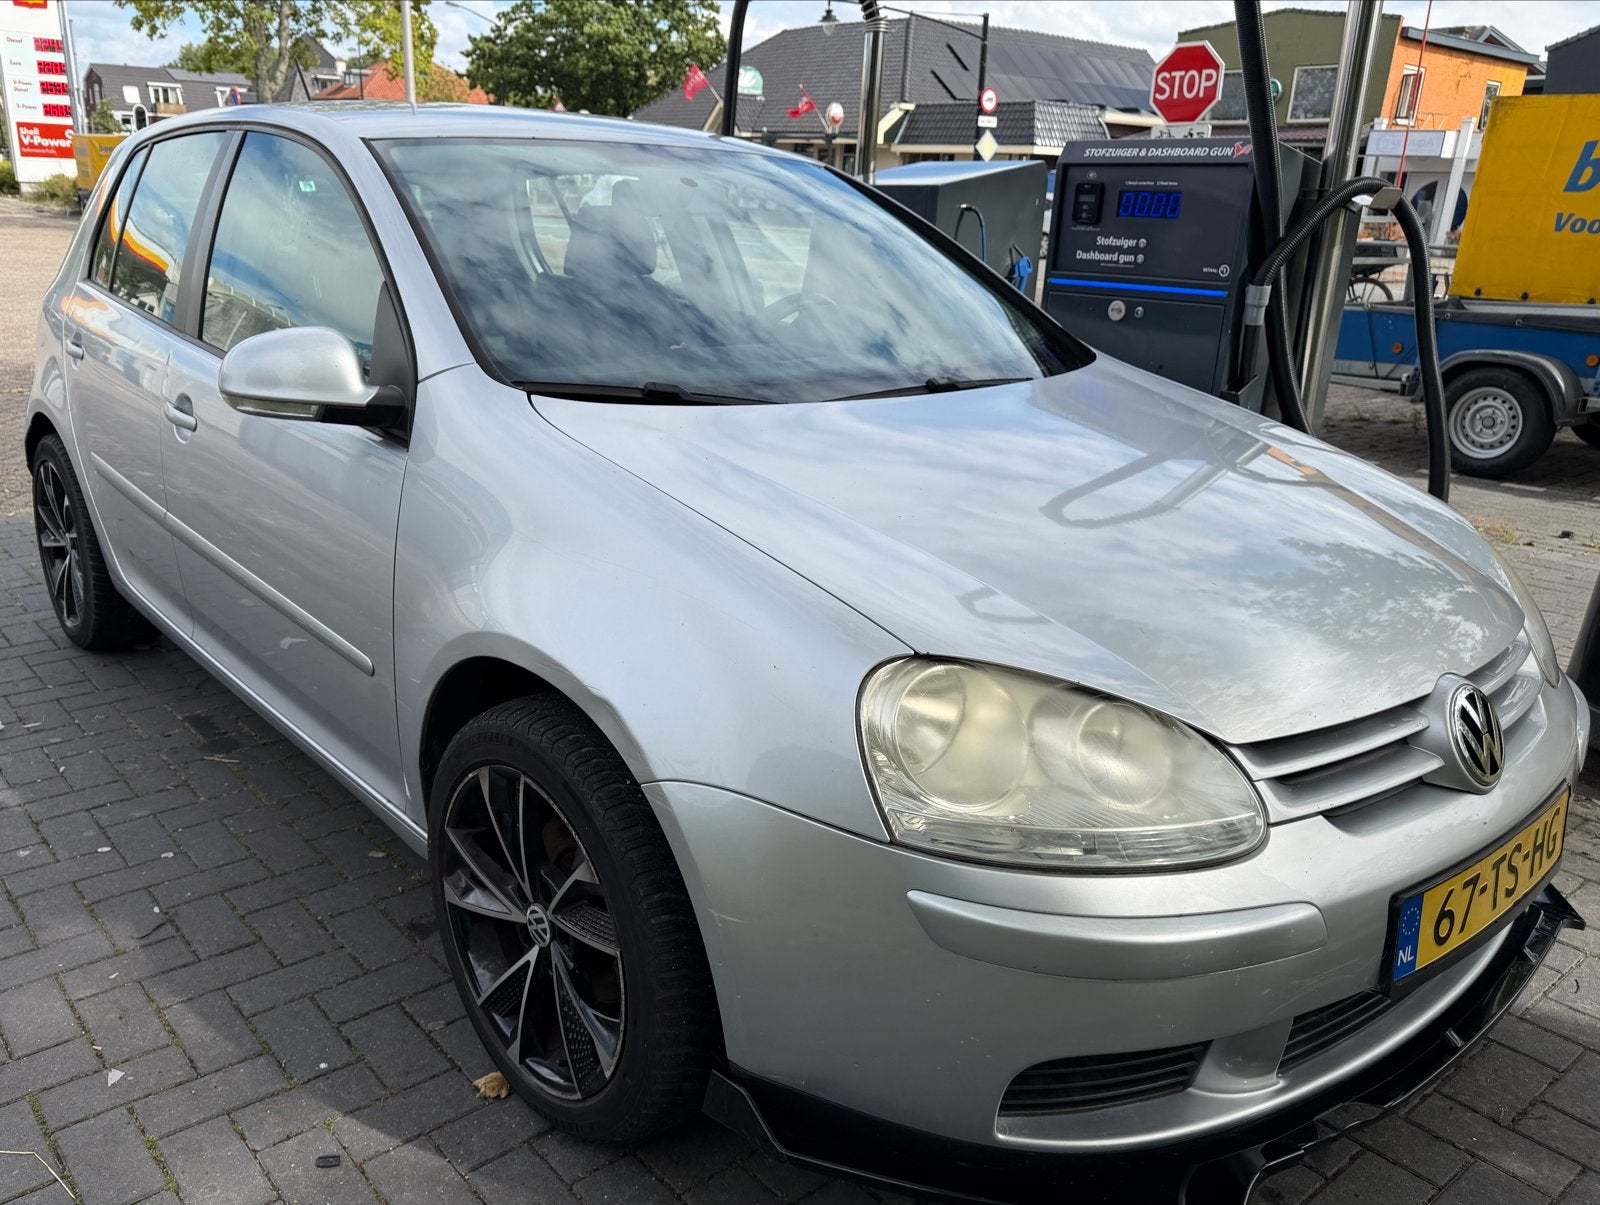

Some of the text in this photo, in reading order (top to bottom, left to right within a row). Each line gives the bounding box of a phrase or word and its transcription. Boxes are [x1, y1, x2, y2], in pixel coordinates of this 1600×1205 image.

[1155, 68, 1217, 101] STOP
[19, 127, 39, 135] Shell
[21, 135, 72, 148] V-Power
[1084, 147, 1234, 157] STOFZUIGER & DASHBOARD GUN
[1096, 236, 1137, 248] Stofzuiger
[1076, 250, 1135, 263] Dashboard gun
[1433, 806, 1561, 947] 67-TS-HG
[1397, 944, 1414, 967] NL
